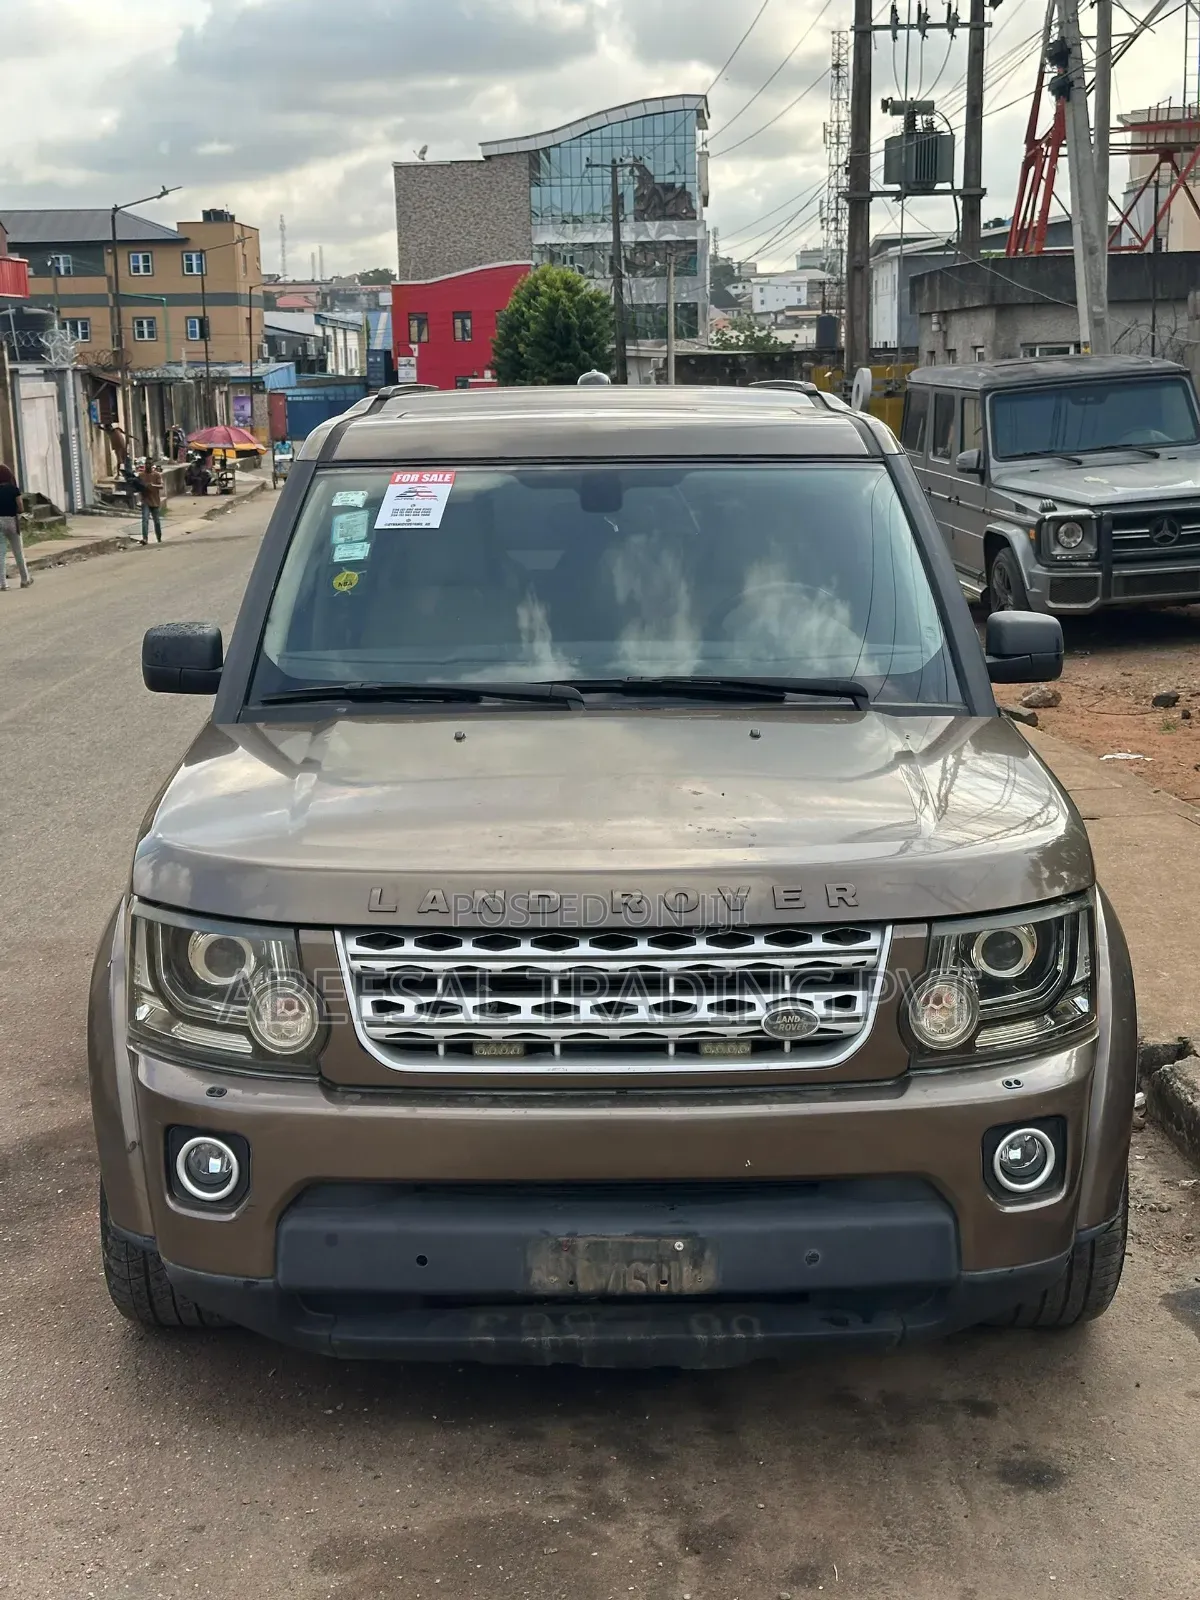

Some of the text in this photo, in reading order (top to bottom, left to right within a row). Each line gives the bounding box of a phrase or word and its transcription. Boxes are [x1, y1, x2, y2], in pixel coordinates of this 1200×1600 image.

[395, 473, 453, 483] FOR SALE
[367, 882, 859, 914] LAND ROVER
[776, 1015, 801, 1024] LAND
[778, 1022, 810, 1032] ROVER
